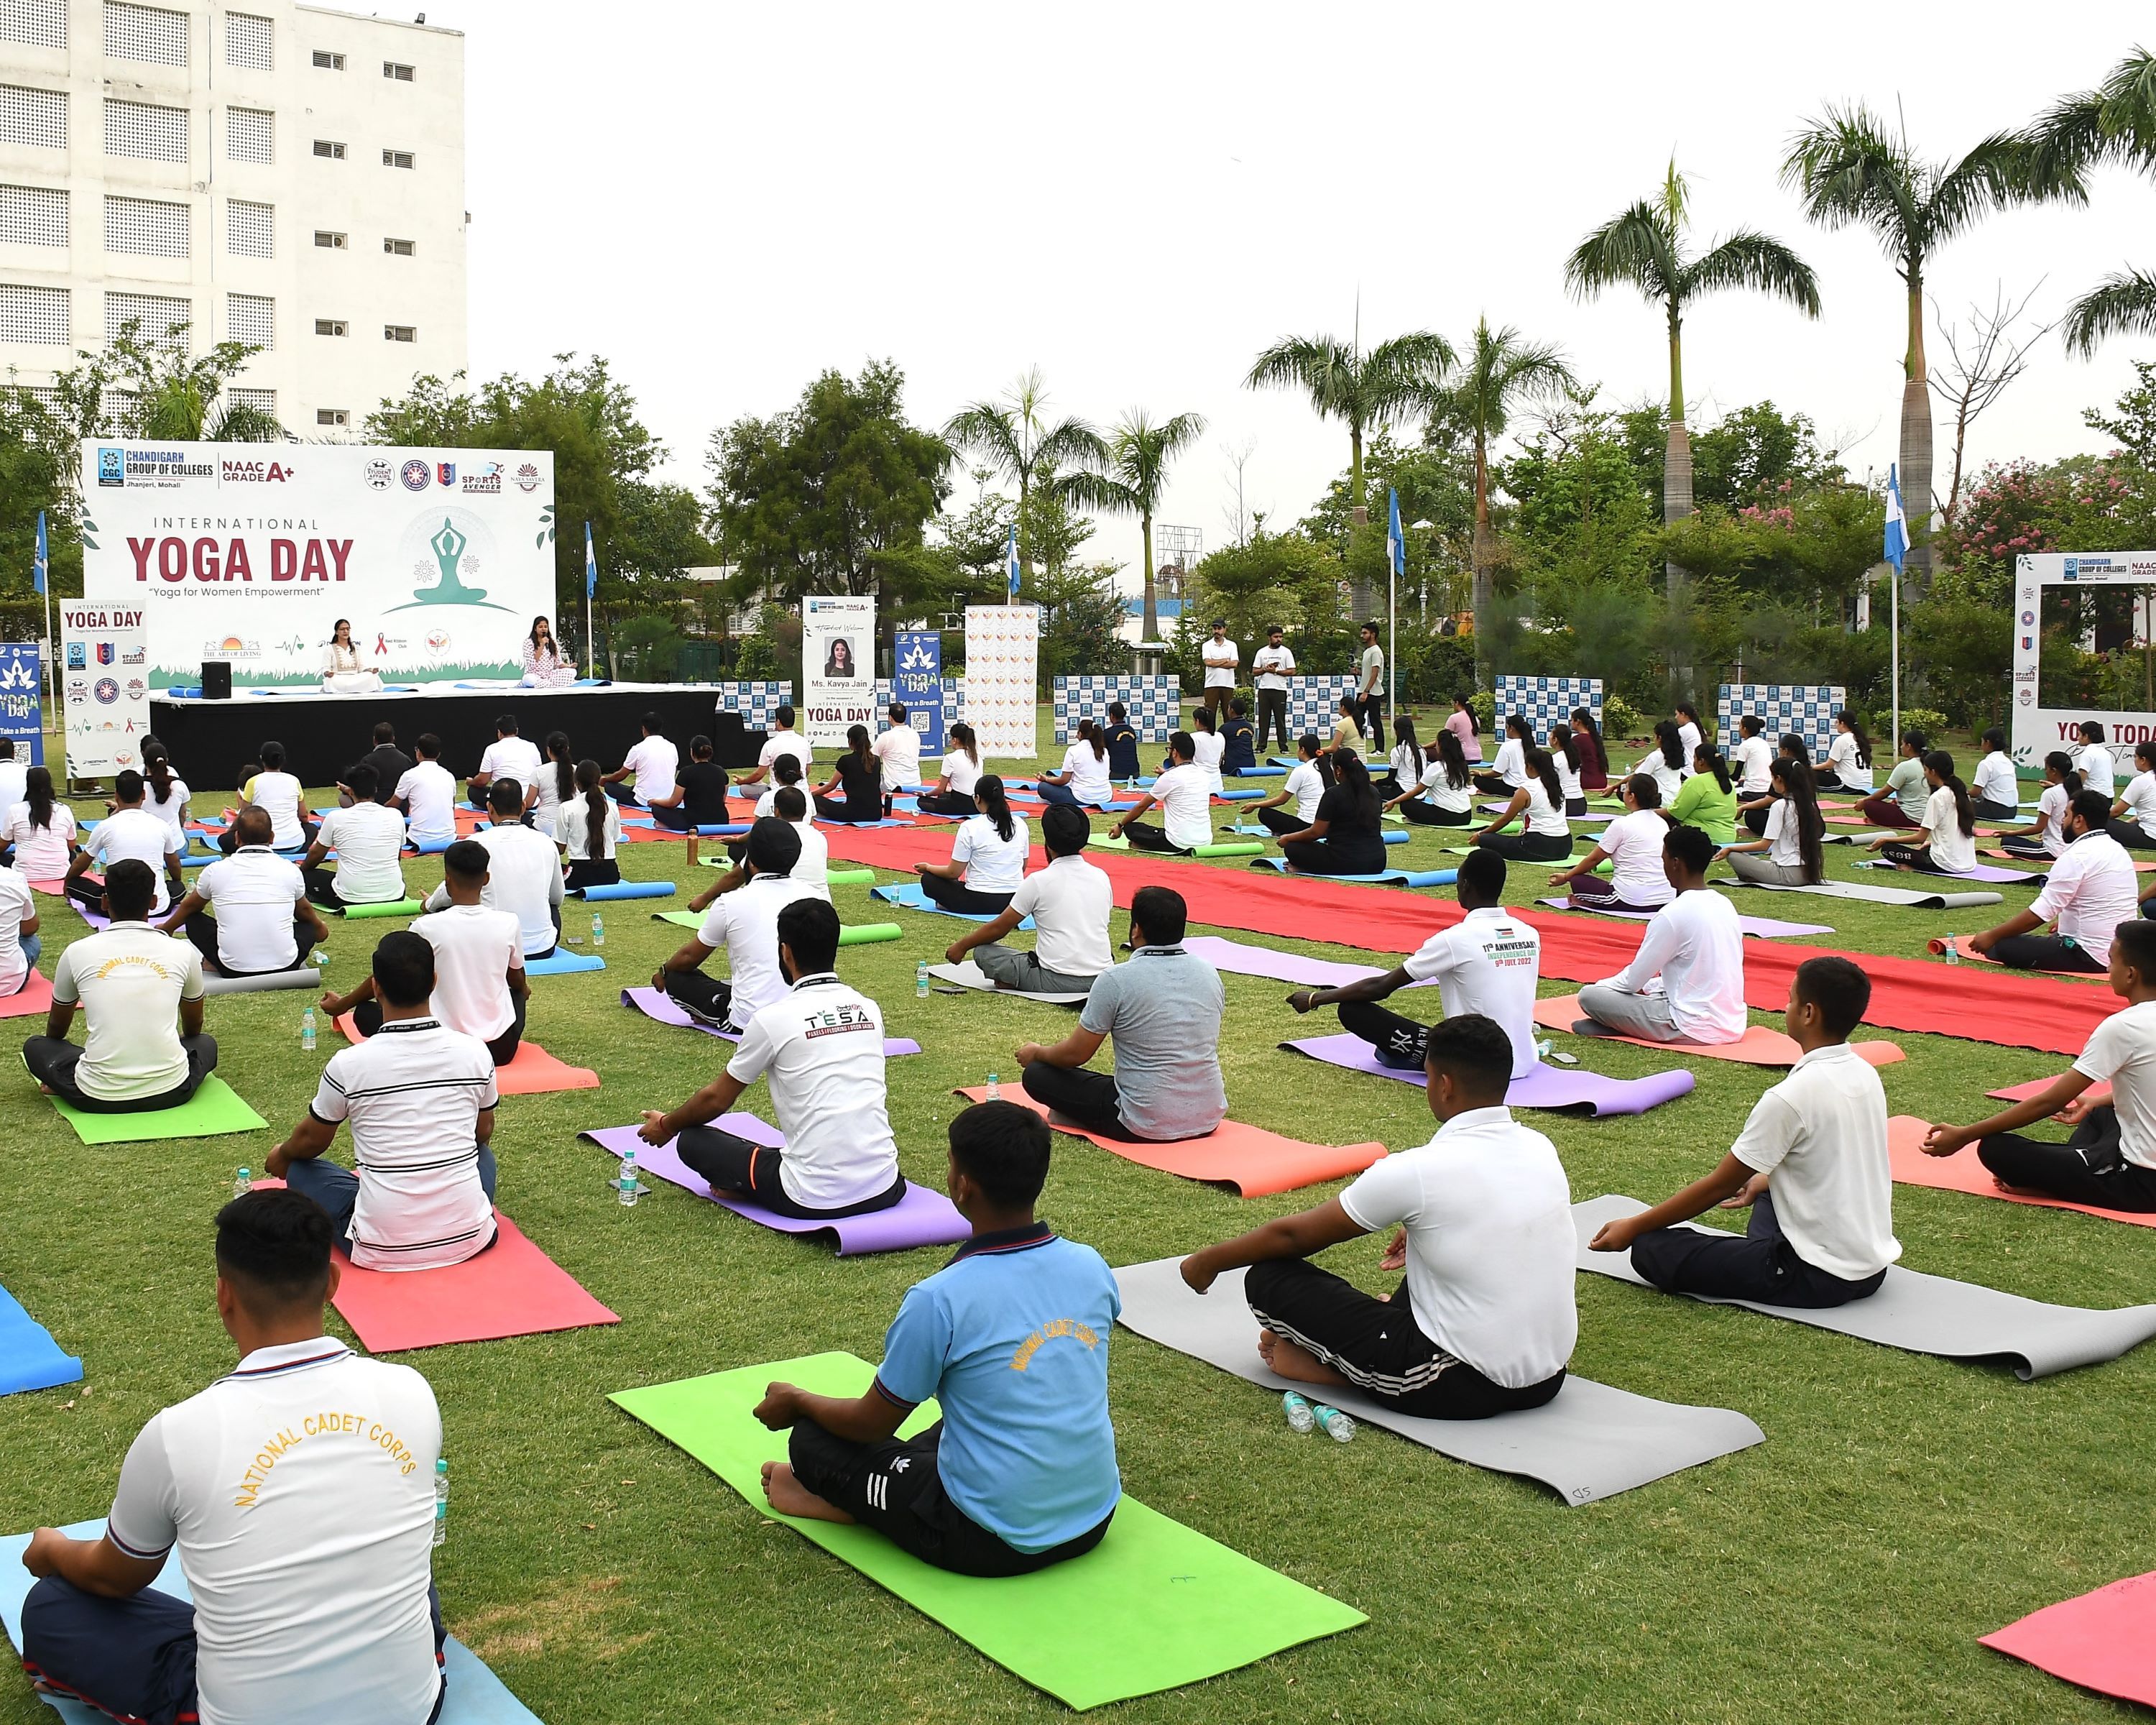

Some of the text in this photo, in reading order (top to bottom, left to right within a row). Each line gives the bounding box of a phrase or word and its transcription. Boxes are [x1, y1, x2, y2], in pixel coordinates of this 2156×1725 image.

[126, 451, 184, 463] CHANDIGARH
[103, 469, 120, 477] CGC
[126, 463, 213, 476] GROUP OF COLLEGES
[223, 461, 264, 473] NAAC
[266, 462, 295, 483] A+
[223, 473, 265, 482] GRADE
[462, 476, 501, 484] SPORTS
[154, 517, 318, 530] INTERNATIONAL
[126, 537, 354, 582] YOGA DAY
[184, 588, 198, 597] for
[201, 588, 242, 597] Women
[65, 611, 143, 627] YOGA DAY
[827, 680, 849, 689] Kavya
[908, 681, 931, 694] Day
[7, 704, 31, 719] Day
[807, 708, 872, 722] YOGA DAY
[1882, 850, 1912, 860] BOSS
[1482, 943, 1494, 952] 11th
[1487, 950, 1526, 960] INDEPENDENCE
[96, 956, 169, 979] NATIONAL CADET CORPS
[1416, 1027, 1429, 1049] NEW
[1044, 1319, 1074, 1338] CADET
[234, 1412, 417, 1506] NATIONAL CADET CORPS
